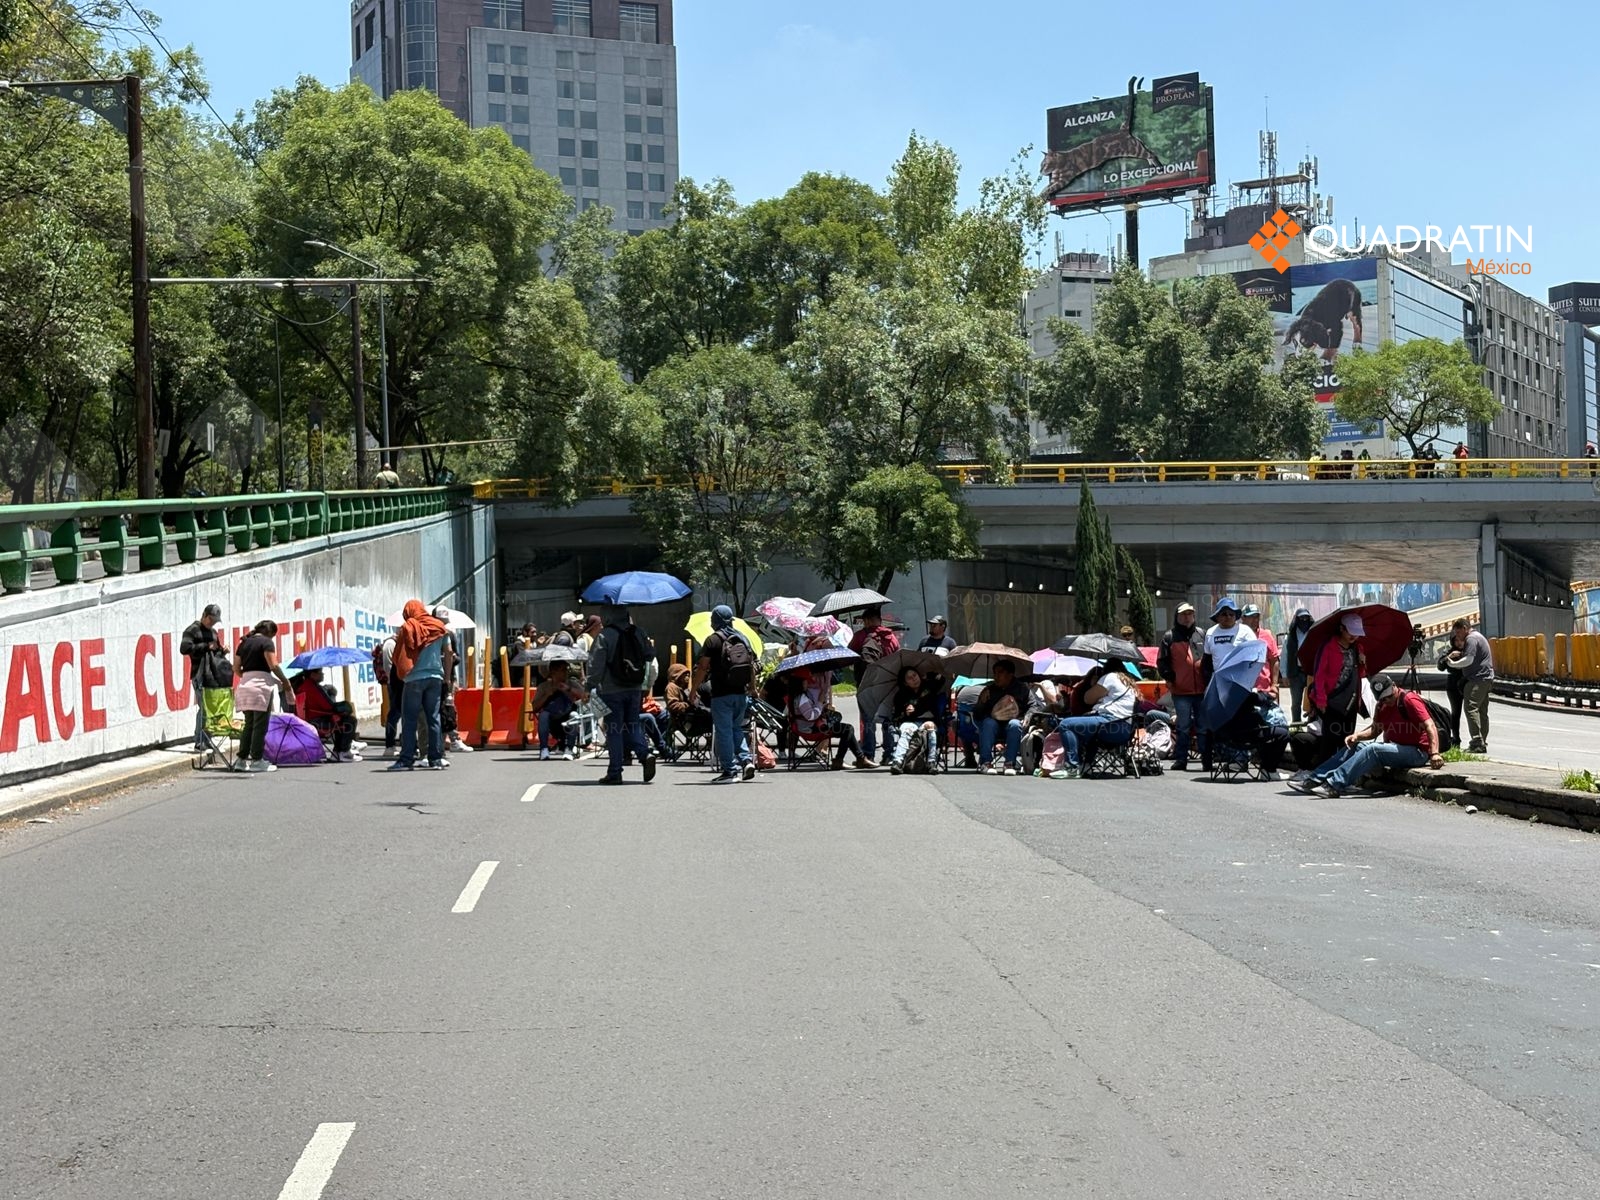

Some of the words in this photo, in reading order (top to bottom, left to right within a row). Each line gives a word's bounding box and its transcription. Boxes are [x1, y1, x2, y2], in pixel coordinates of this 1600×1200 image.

[1155, 95, 1173, 104] PRO
[1173, 91, 1195, 101] PLAN
[1064, 111, 1116, 128] ALCANZA
[1103, 173, 1119, 184] LO
[1120, 161, 1198, 181] EXCEPCIONAL
[0, 638, 107, 753] ACE
